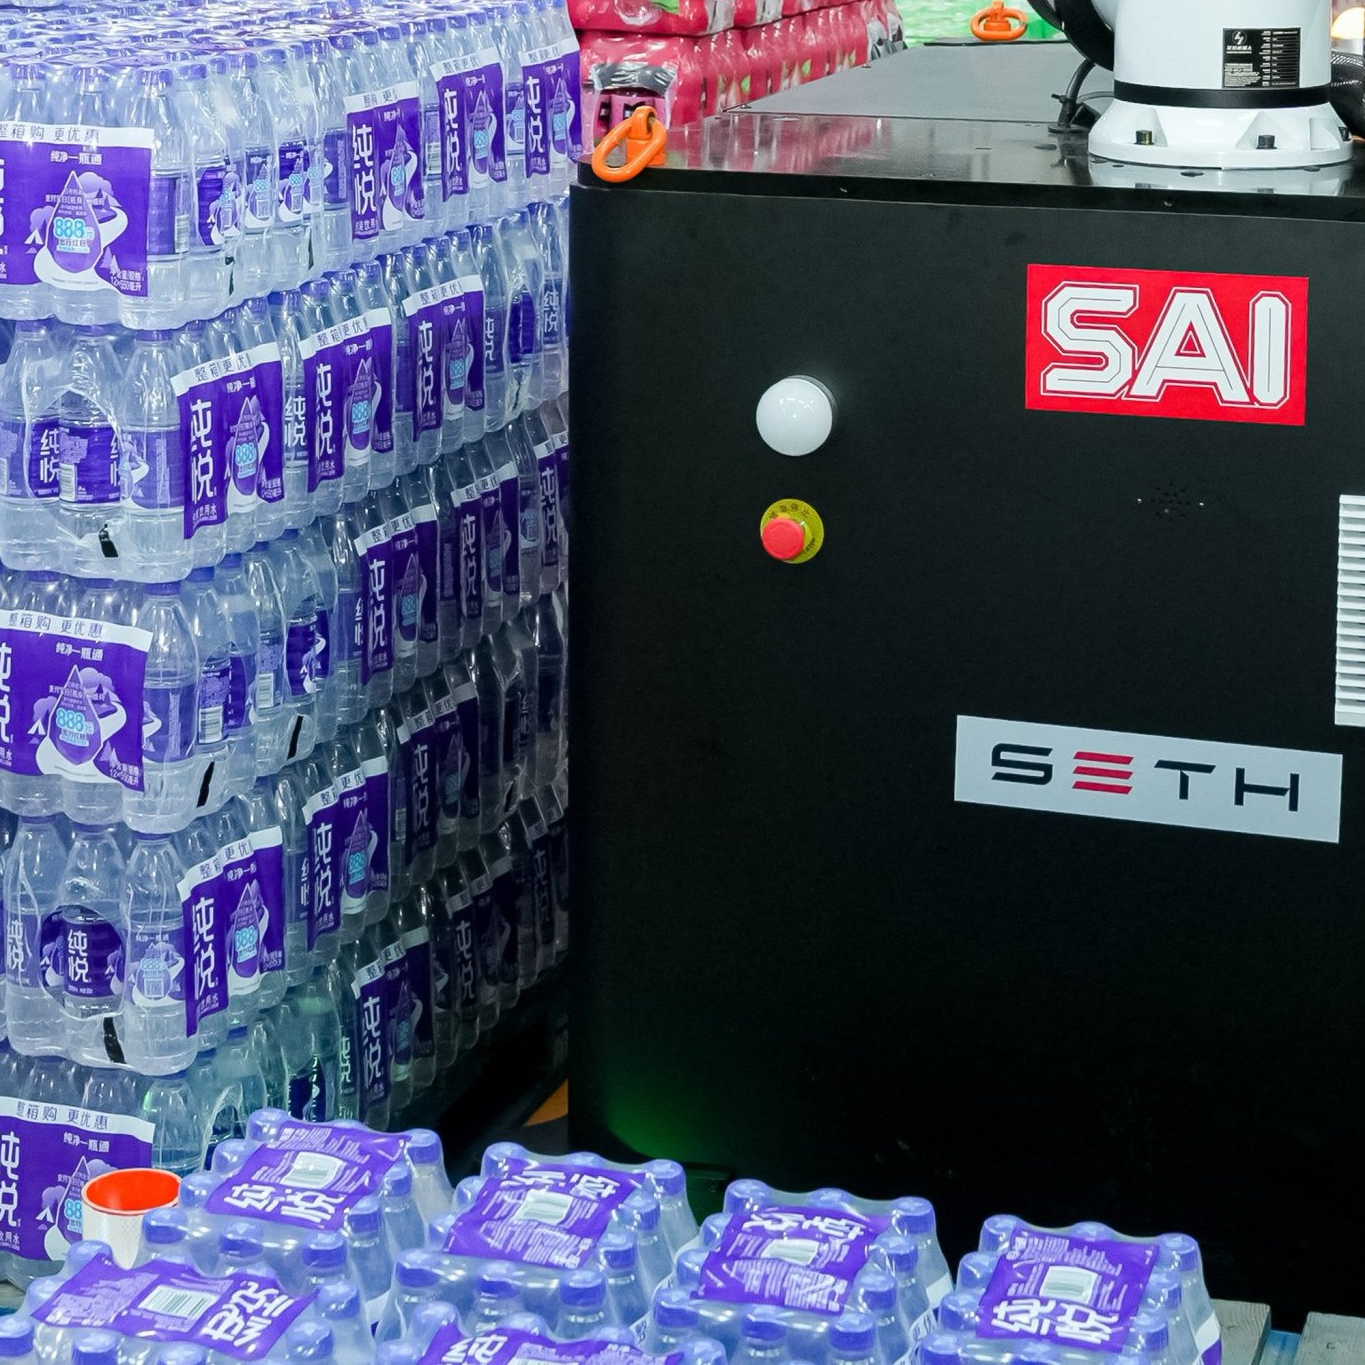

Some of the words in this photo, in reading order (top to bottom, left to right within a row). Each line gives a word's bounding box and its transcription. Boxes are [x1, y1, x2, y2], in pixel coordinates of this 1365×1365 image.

[54, 127, 99, 143] 更优惠
[353, 124, 377, 215] 纯悦
[1040, 281, 1291, 409] SAI
[284, 395, 306, 447] 纯悦
[190, 399, 213, 505] 纯悦
[60, 619, 102, 638] 更优惠
[991, 742, 1299, 812] SETH
[68, 929, 89, 983] 纯悦
[67, 1110, 108, 1130] 更优惠
[64, 1198, 82, 1217] 88
[223, 1181, 345, 1223] 纯悦
[199, 1281, 293, 1347] 纯悦
[991, 1298, 1118, 1344] 纯悦
